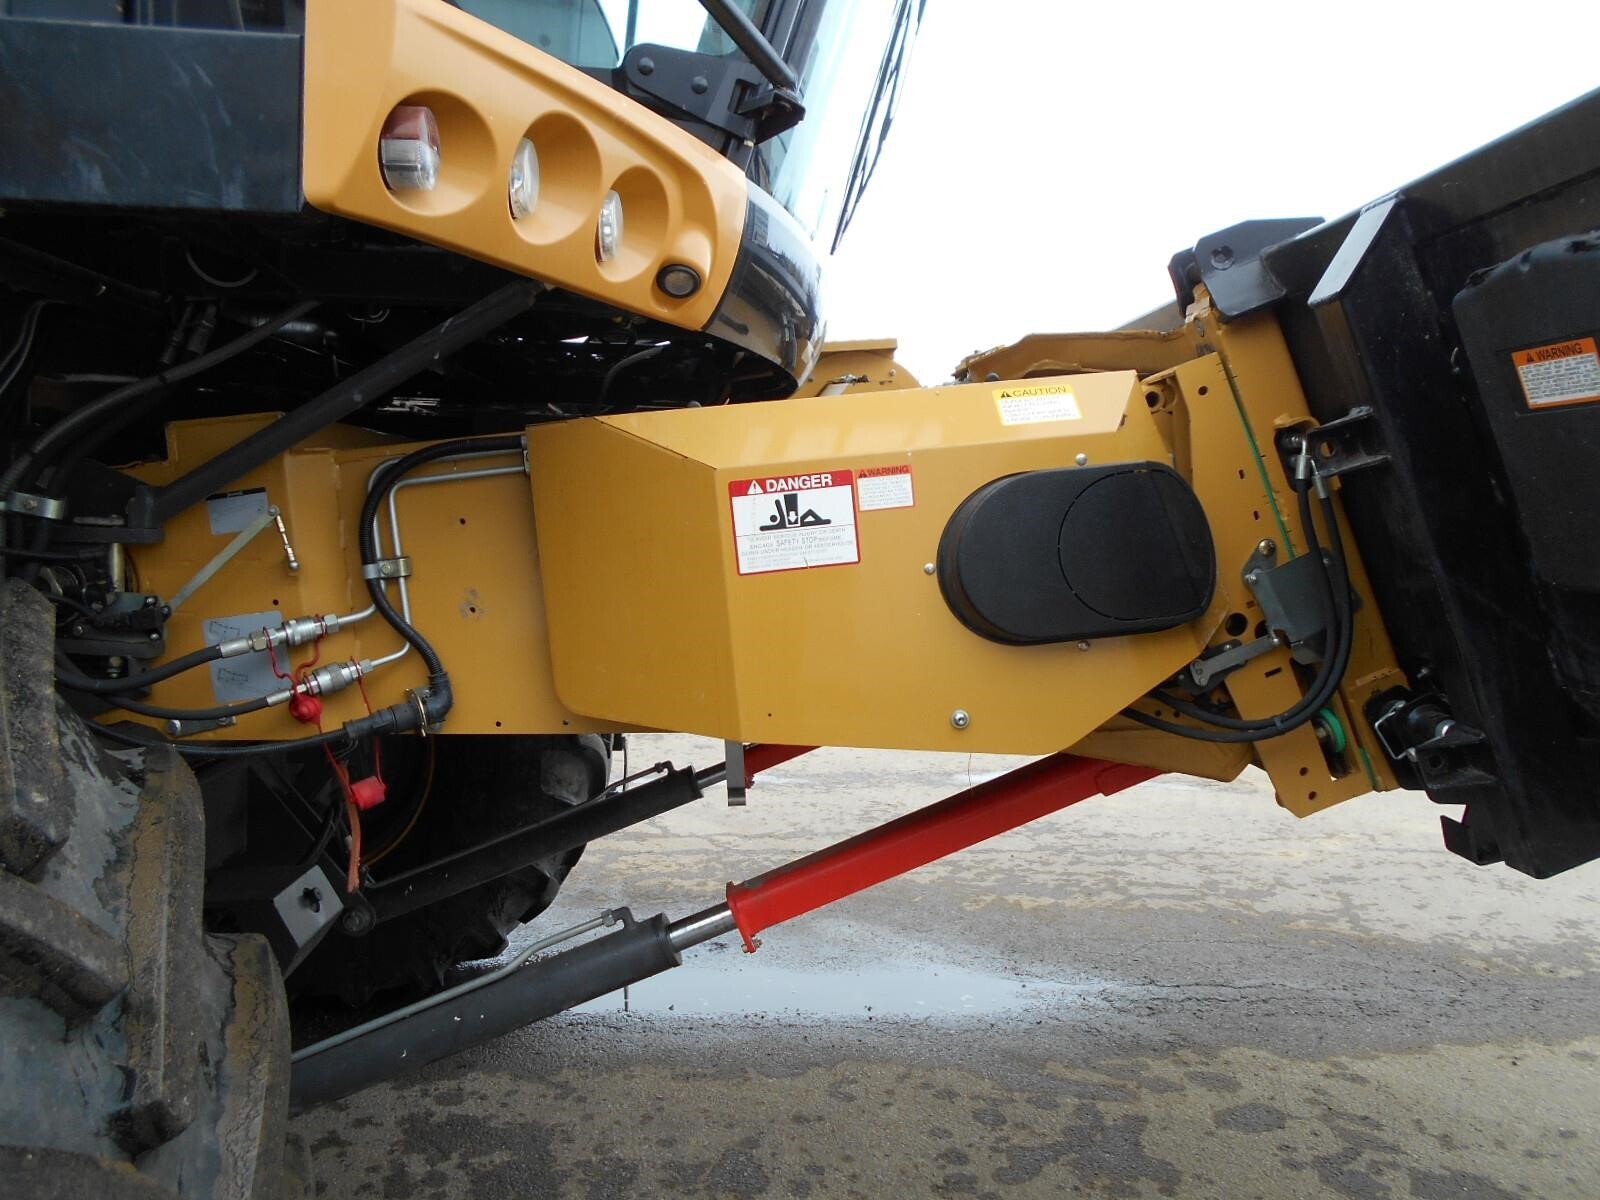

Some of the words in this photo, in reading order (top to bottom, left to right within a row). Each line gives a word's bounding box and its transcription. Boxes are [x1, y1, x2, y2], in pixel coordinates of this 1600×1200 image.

[1536, 342, 1582, 361] WARNING
[1012, 385, 1066, 397] CAUTION
[866, 465, 909, 477] WARNING
[765, 473, 832, 492] DANGER
[776, 539, 799, 547] SAFETY
[801, 537, 817, 545] STOP
